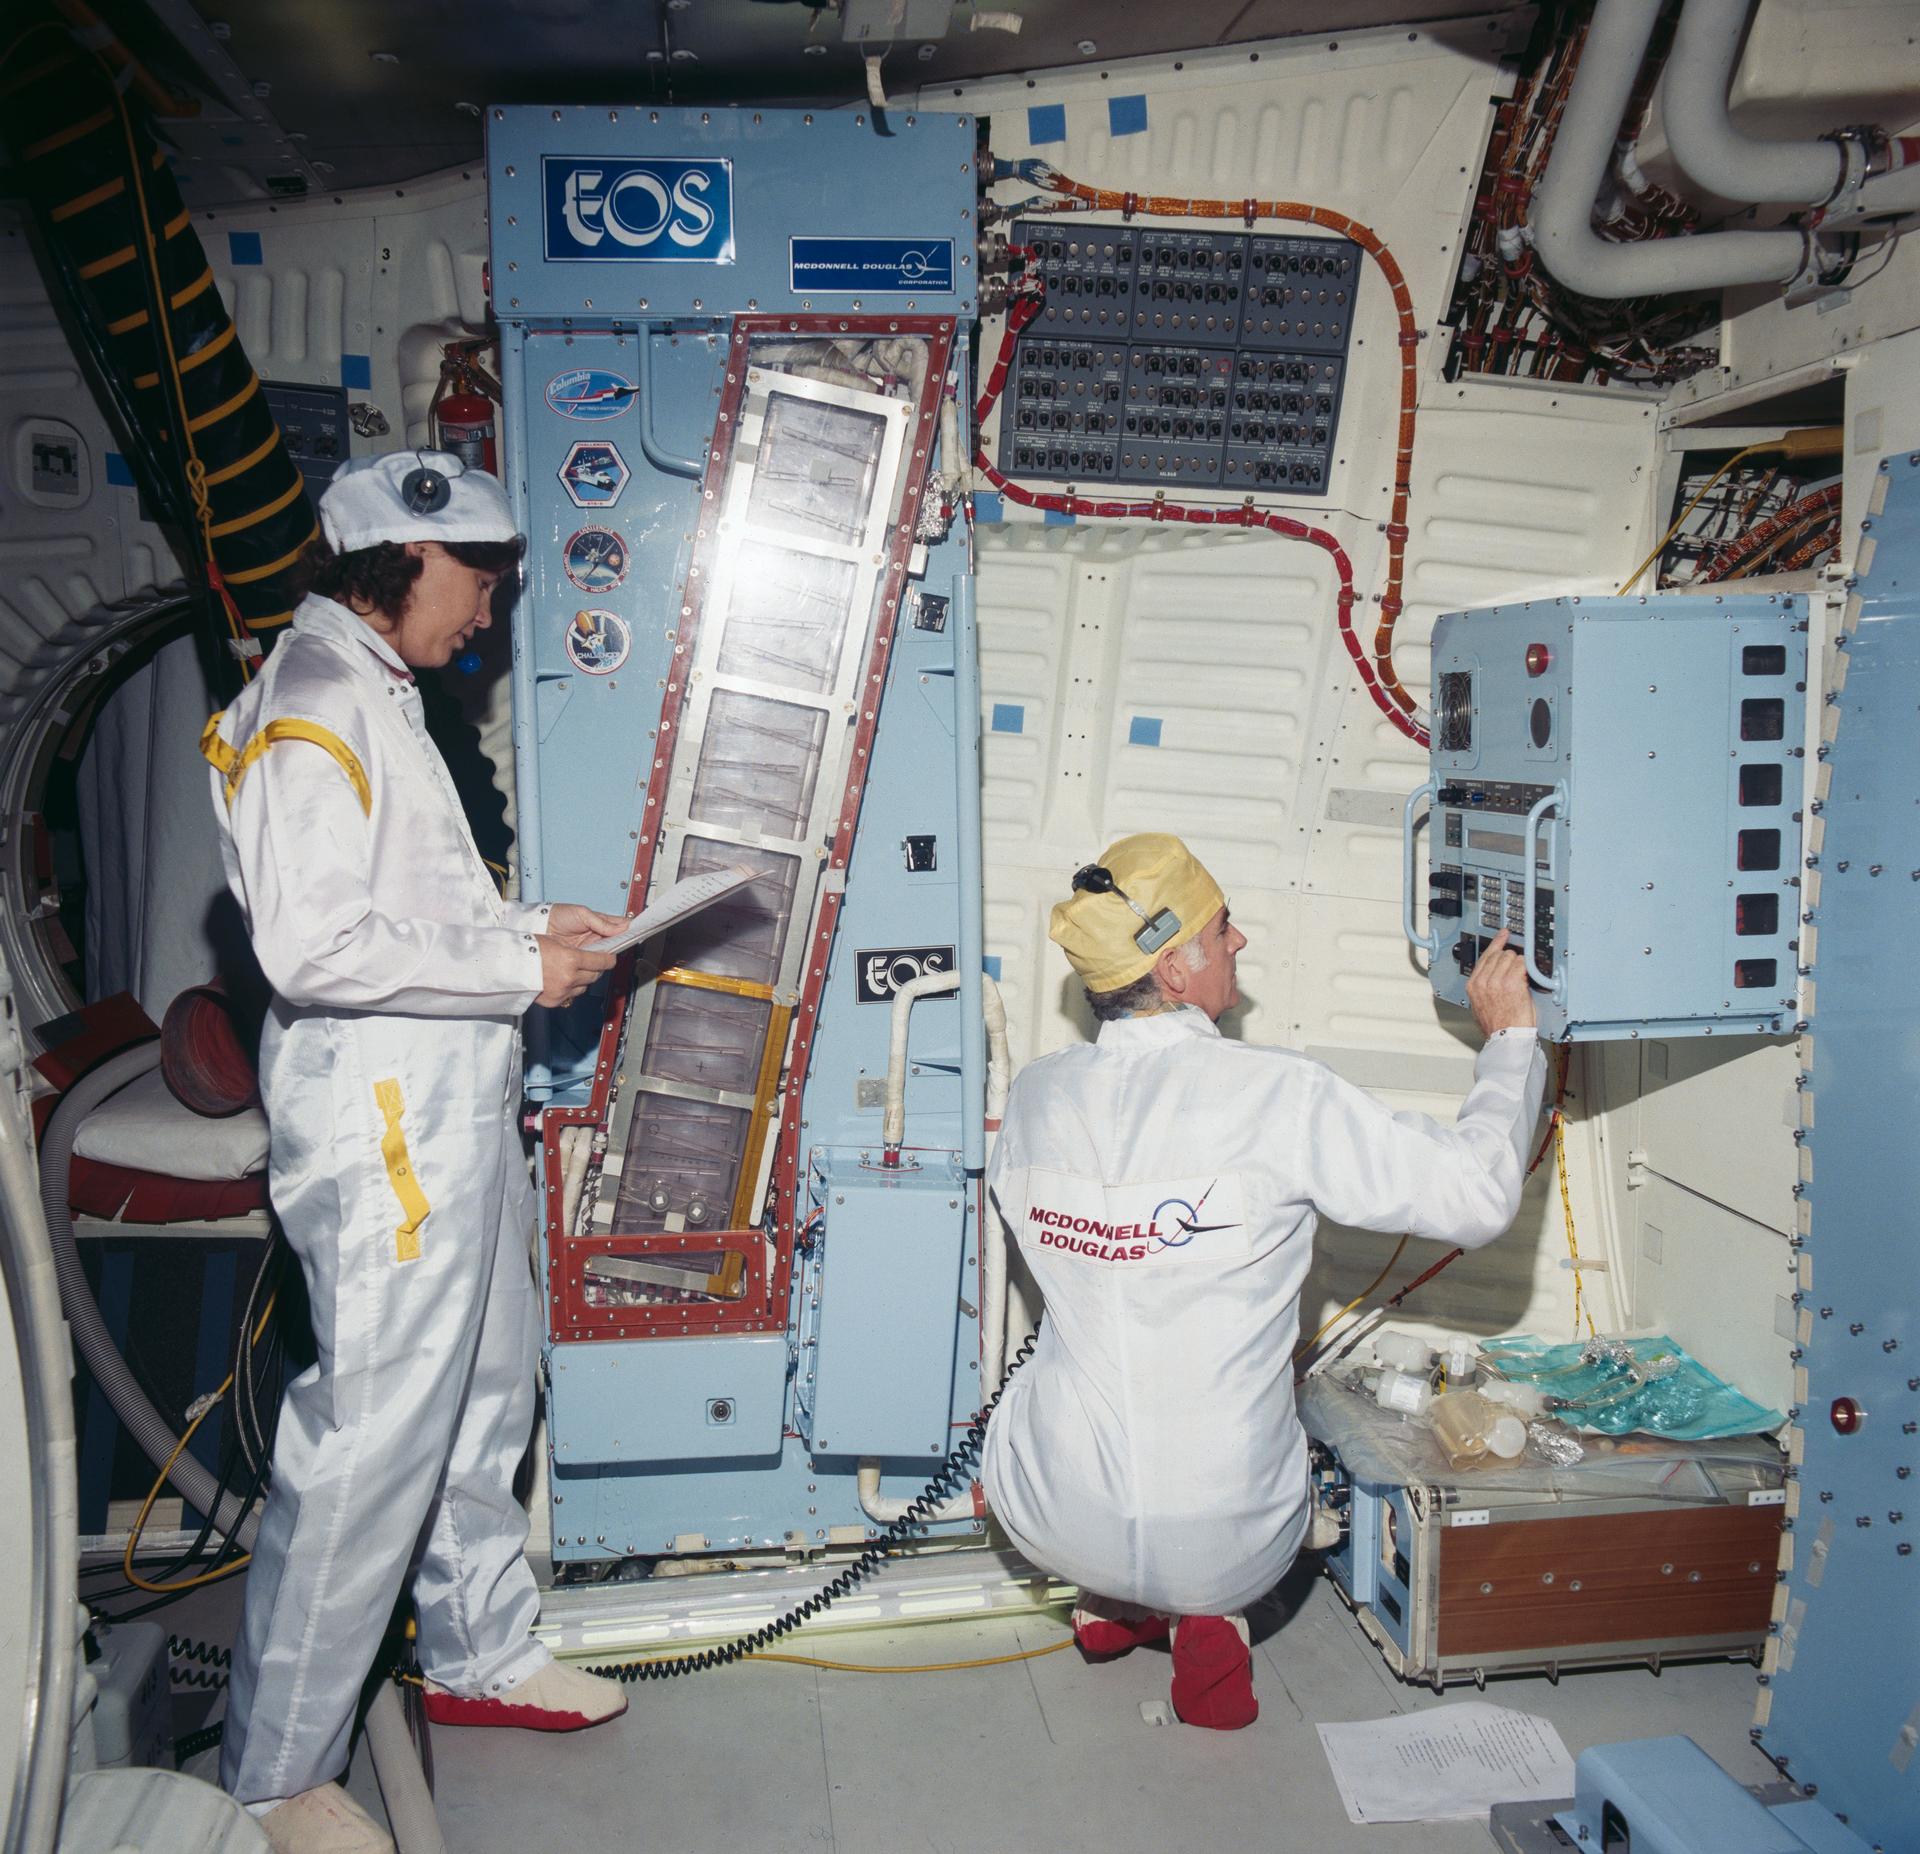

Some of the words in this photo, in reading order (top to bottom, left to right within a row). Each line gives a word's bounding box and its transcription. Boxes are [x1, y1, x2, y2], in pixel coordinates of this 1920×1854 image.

[562, 169, 715, 247] EOS
[382, 248, 390, 260] 3
[794, 262, 859, 270] MCDONNELL
[862, 263, 912, 271] DOUGLAS
[549, 371, 592, 395] Columbia
[1029, 1207, 1163, 1241] MCDONNELL
[1040, 1231, 1146, 1261] DOUGLAS
